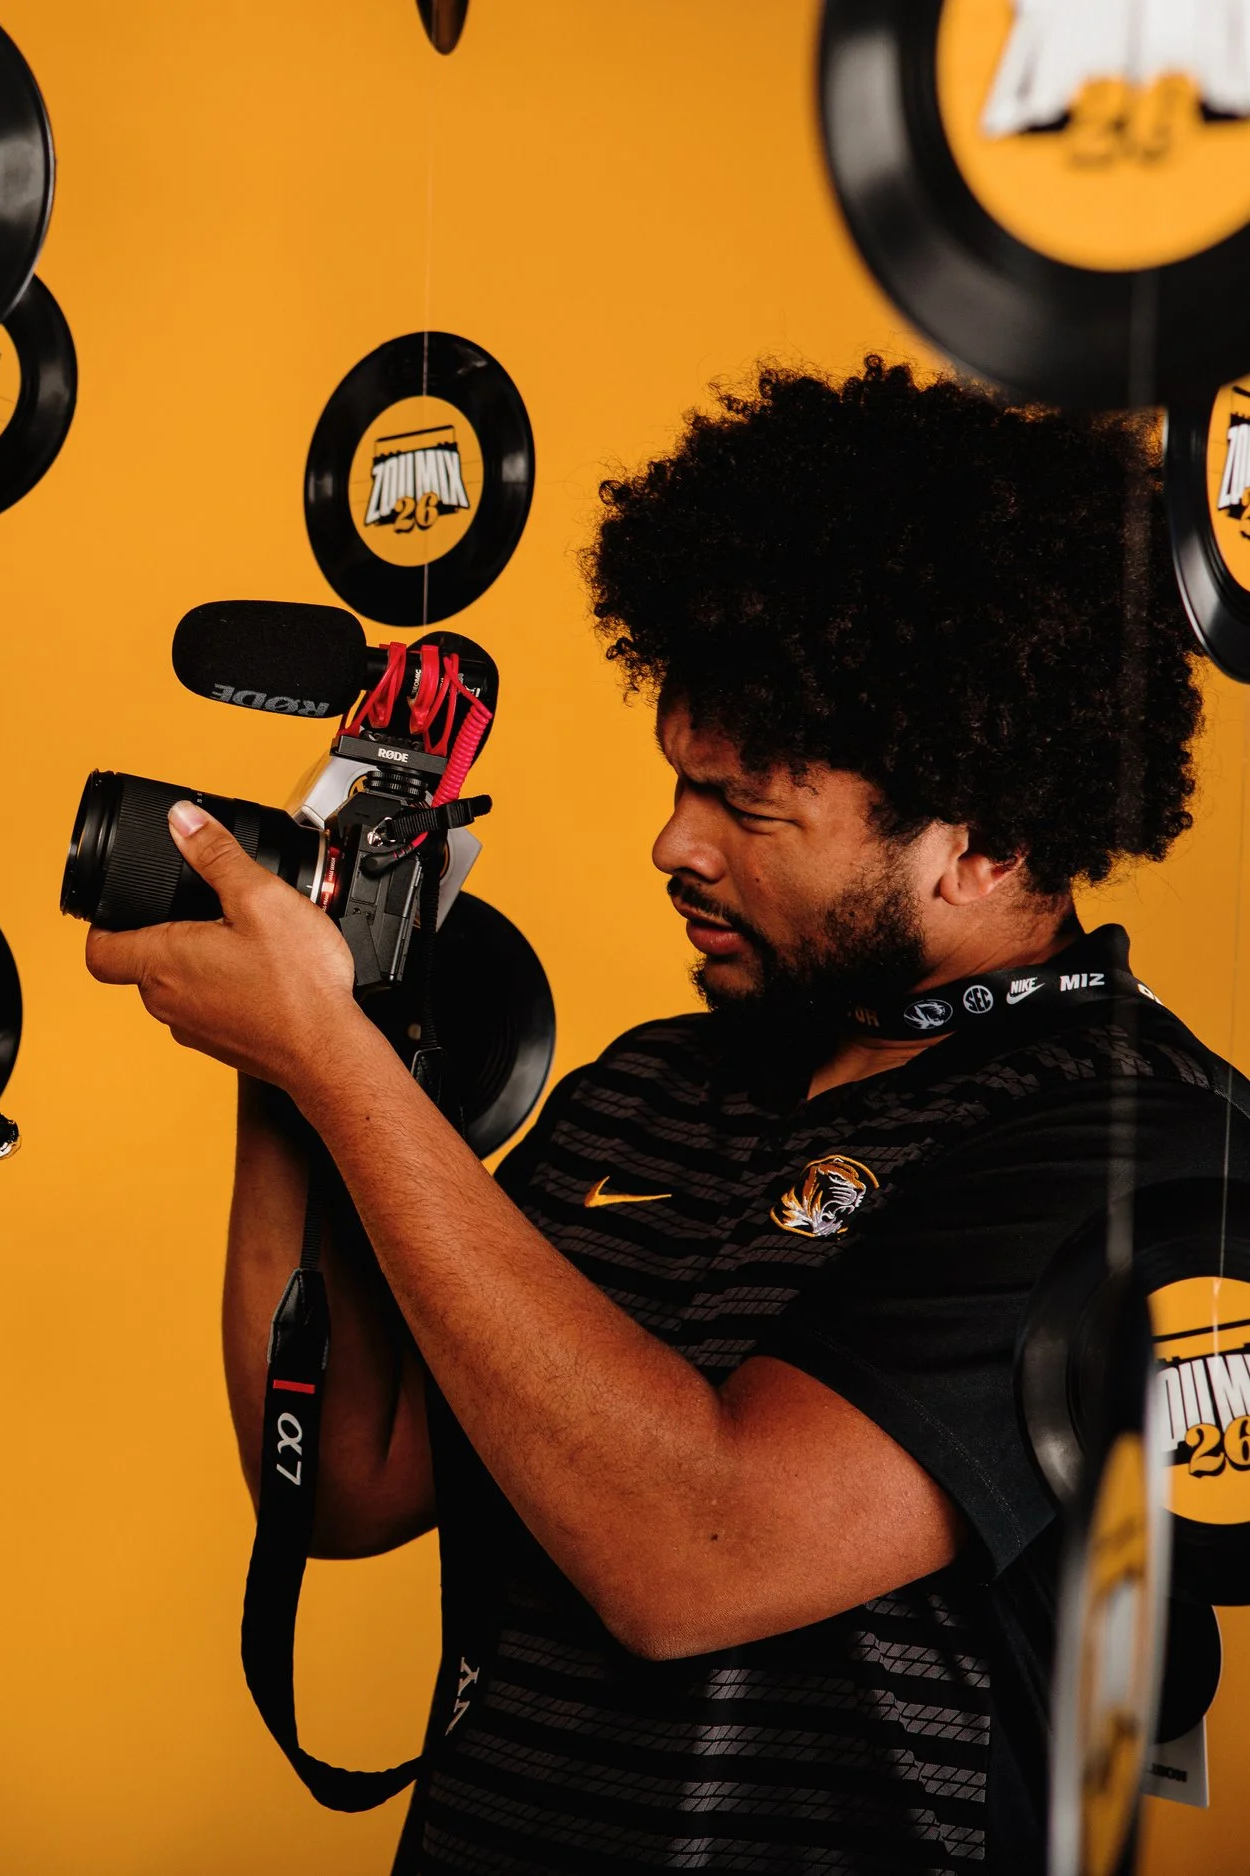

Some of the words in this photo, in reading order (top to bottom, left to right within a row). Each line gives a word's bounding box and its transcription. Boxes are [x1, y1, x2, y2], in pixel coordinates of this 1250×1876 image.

[394, 491, 440, 534] 26
[377, 747, 410, 763] RØDE
[964, 986, 993, 1013] SEC
[1010, 977, 1039, 995] NIKE
[1059, 972, 1105, 992] MIZ
[1184, 1414, 1250, 1478] 26
